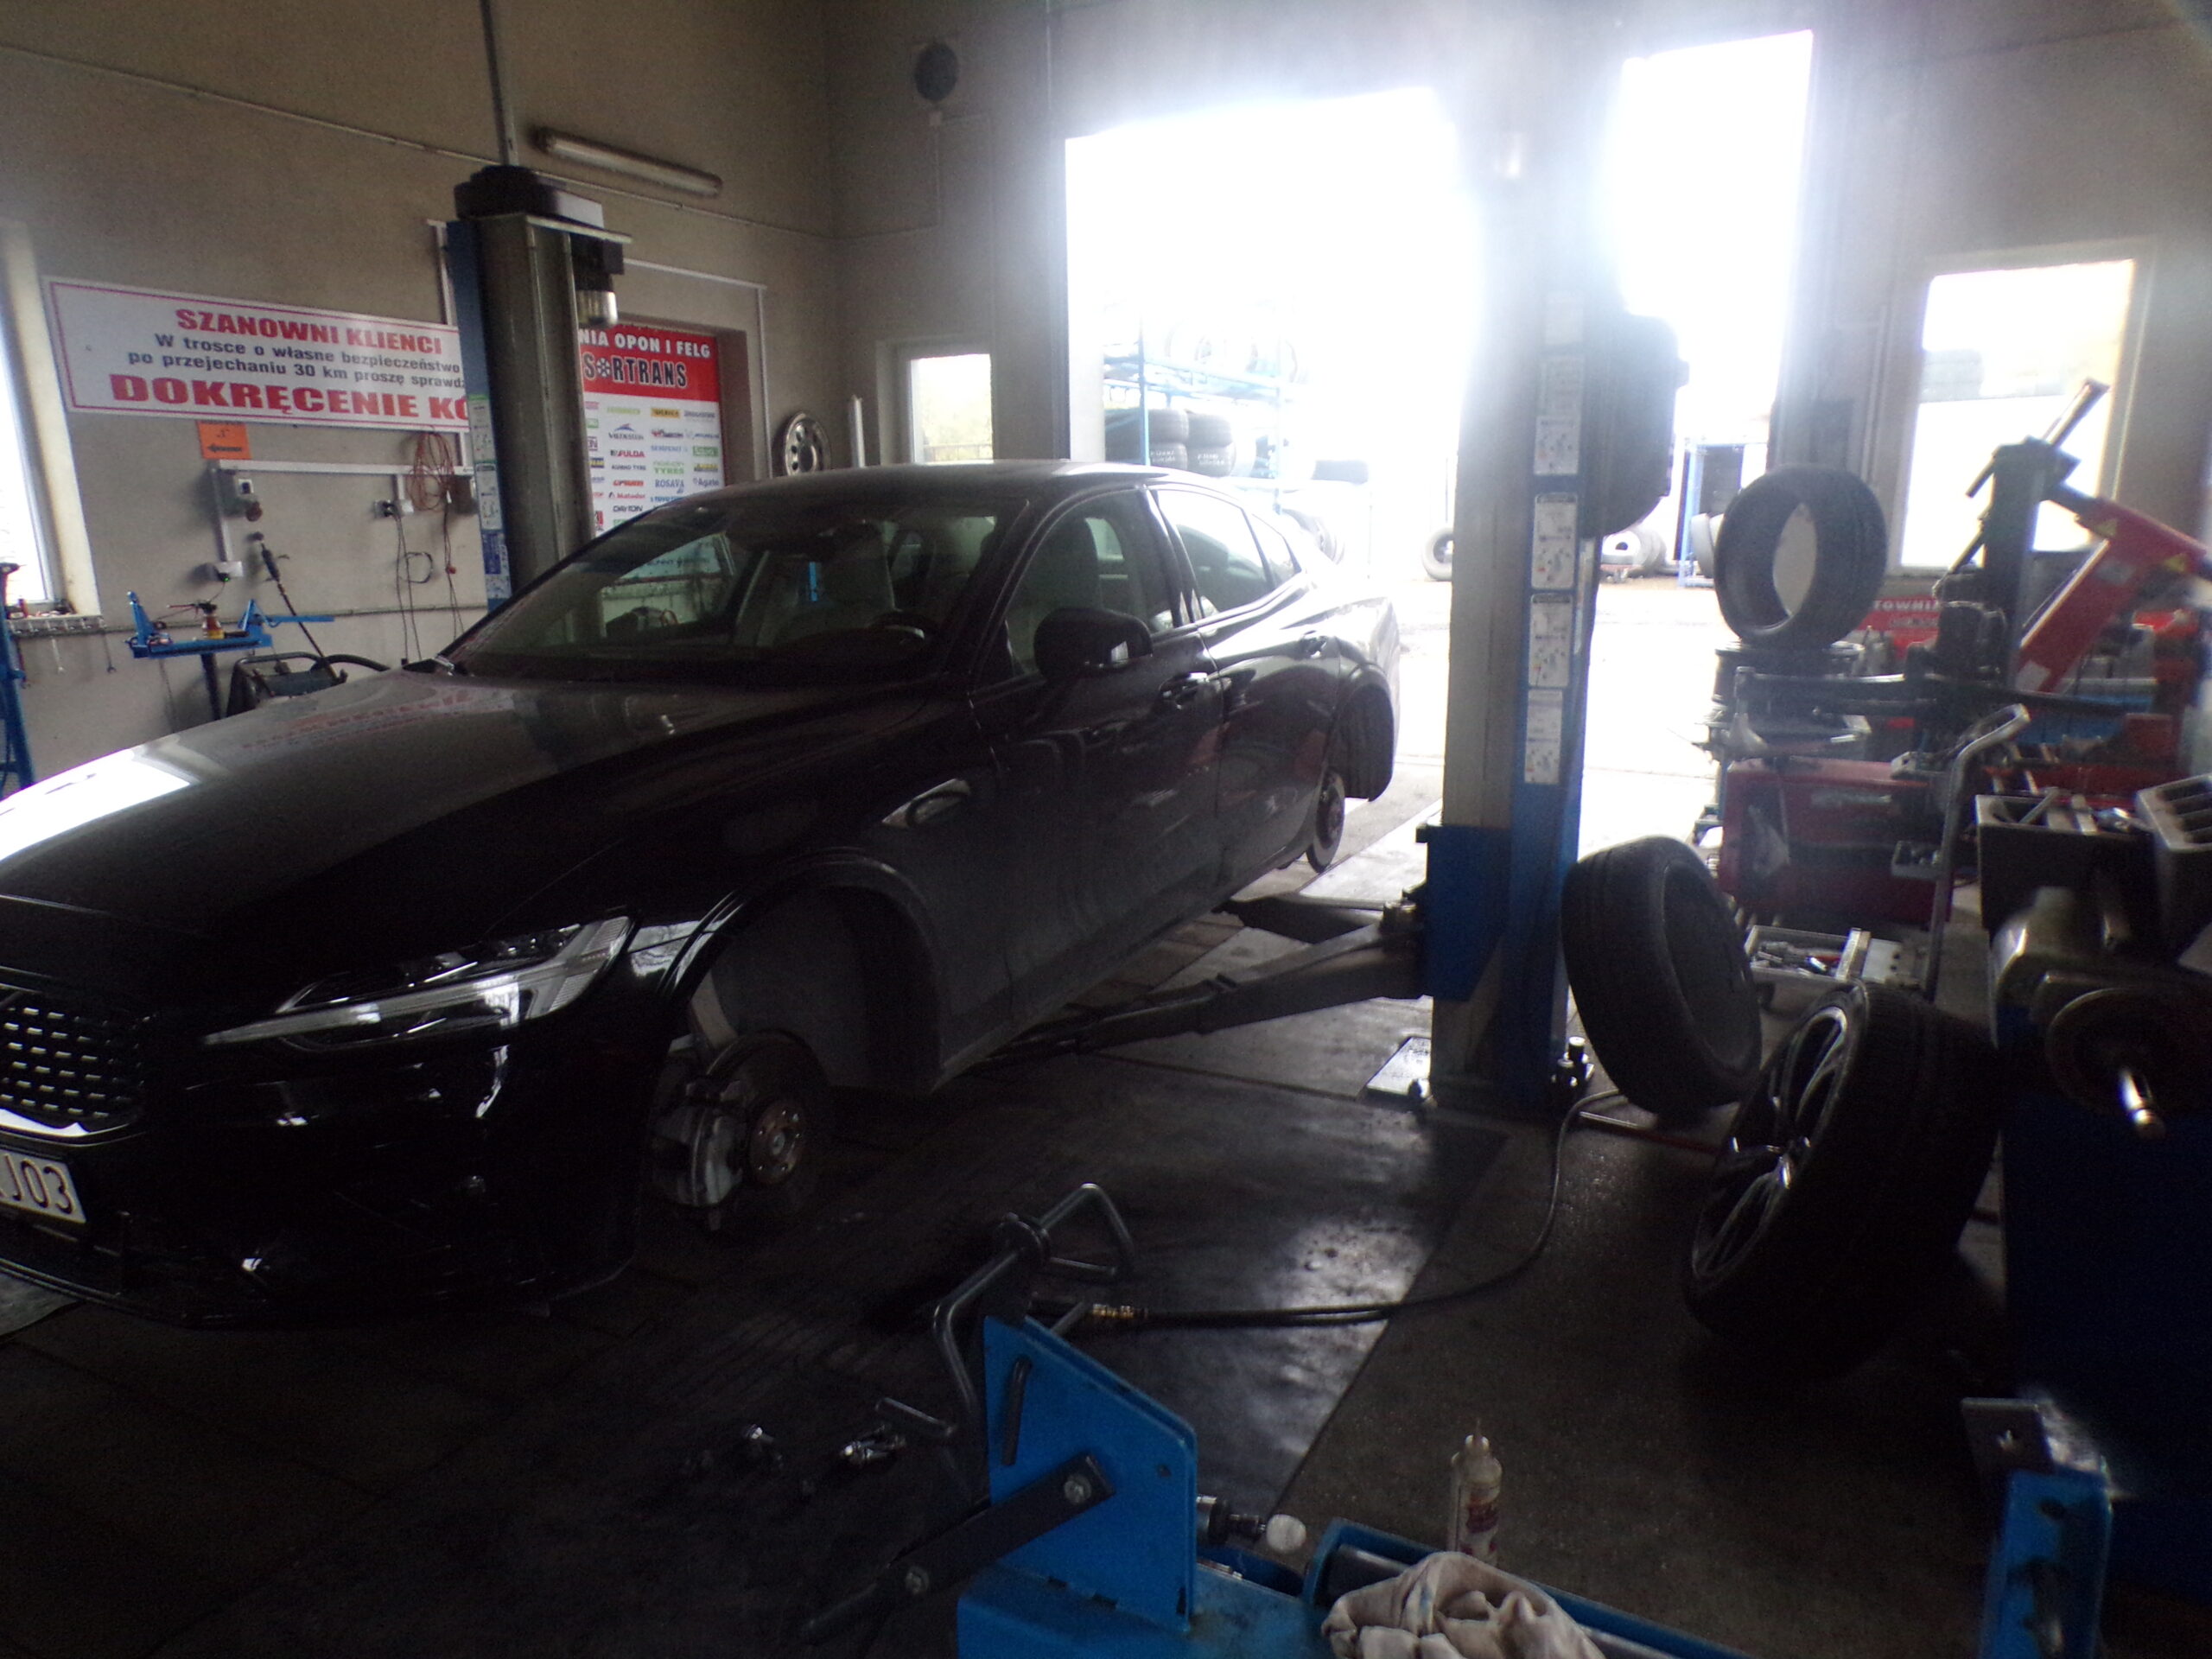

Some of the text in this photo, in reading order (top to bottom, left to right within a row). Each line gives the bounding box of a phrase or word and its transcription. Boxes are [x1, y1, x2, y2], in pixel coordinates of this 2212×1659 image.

[175, 308, 442, 355] SZANOWNI KLIENCI
[614, 333, 660, 353] OPON
[665, 340, 671, 353] I
[676, 341, 711, 358] FELG
[129, 352, 153, 365] po
[162, 355, 286, 374] przejechaniu
[294, 364, 315, 377] 30
[322, 365, 347, 378] km
[354, 371, 404, 385] proszę
[154, 334, 460, 373] W trosce o własne bezpieczeństwo
[109, 374, 419, 417] DOKRĘCENIE
[0, 1154, 75, 1214] J03
